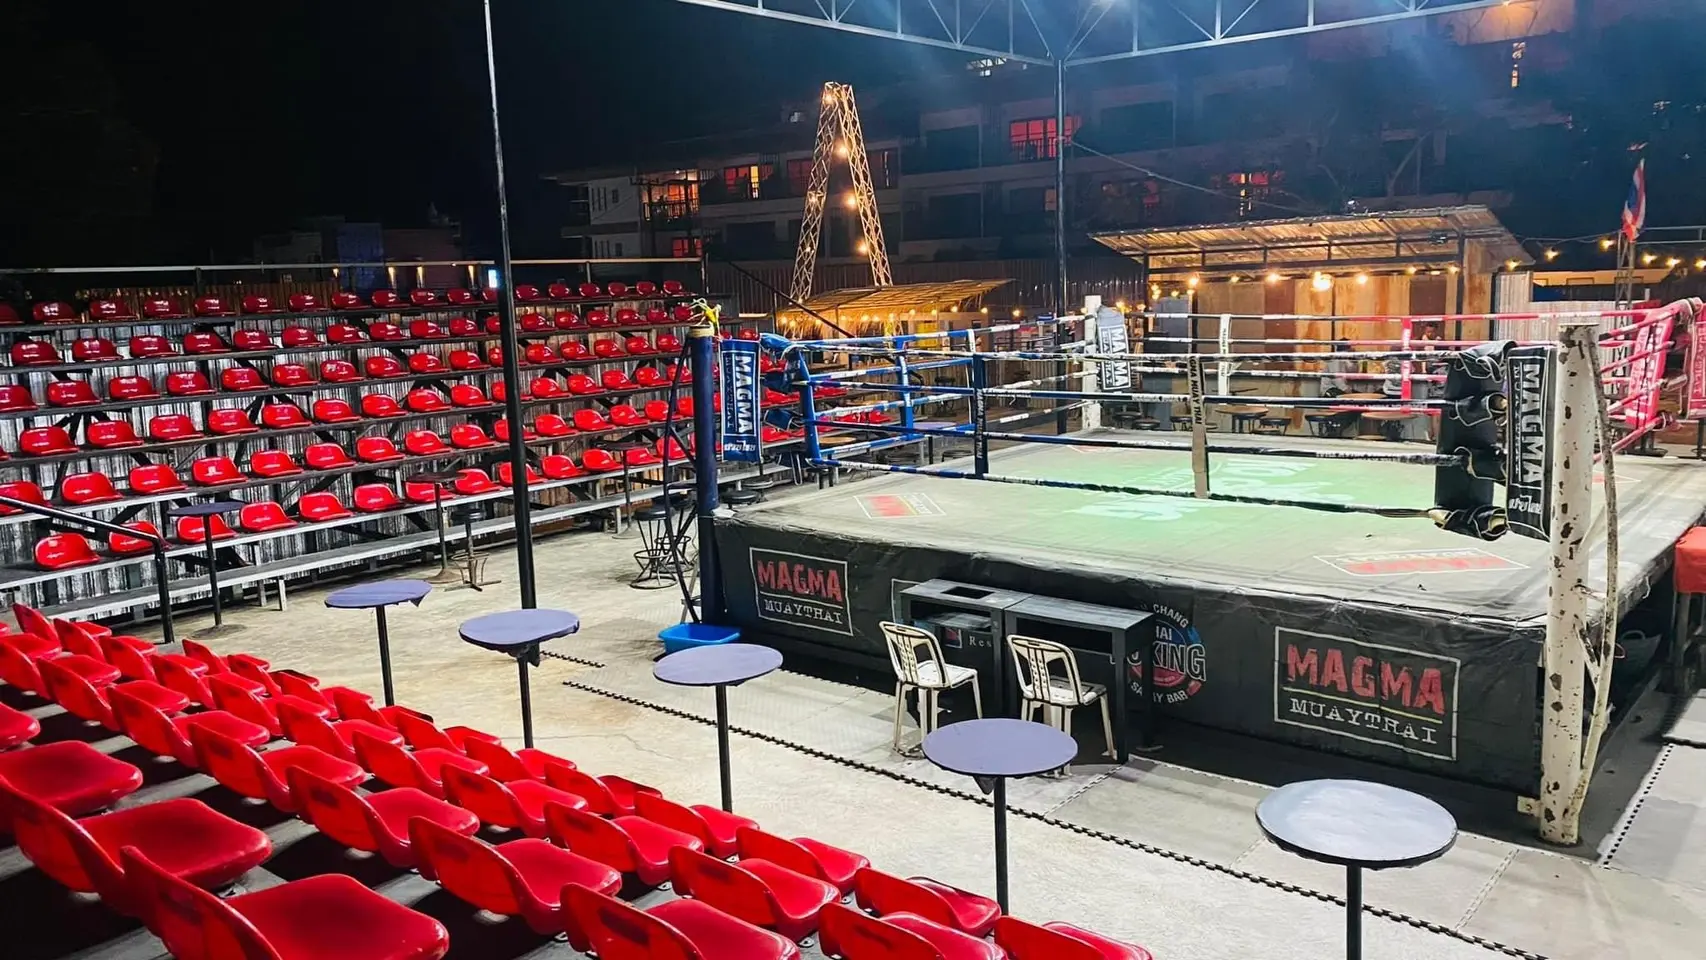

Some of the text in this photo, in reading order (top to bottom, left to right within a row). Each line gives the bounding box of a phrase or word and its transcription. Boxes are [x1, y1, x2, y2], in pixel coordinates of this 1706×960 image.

[1111, 328, 1129, 388] MAMA
[735, 356, 753, 433] MAGMA
[1189, 356, 1202, 425] GMA MUAY THAI
[1521, 364, 1544, 483] MAGMA
[757, 560, 842, 601] MAGMA
[764, 599, 843, 624] MUAYTHAI
[1153, 603, 1189, 628] CHANG
[1167, 690, 1188, 703] BAR
[1287, 644, 1445, 715] MAGMA
